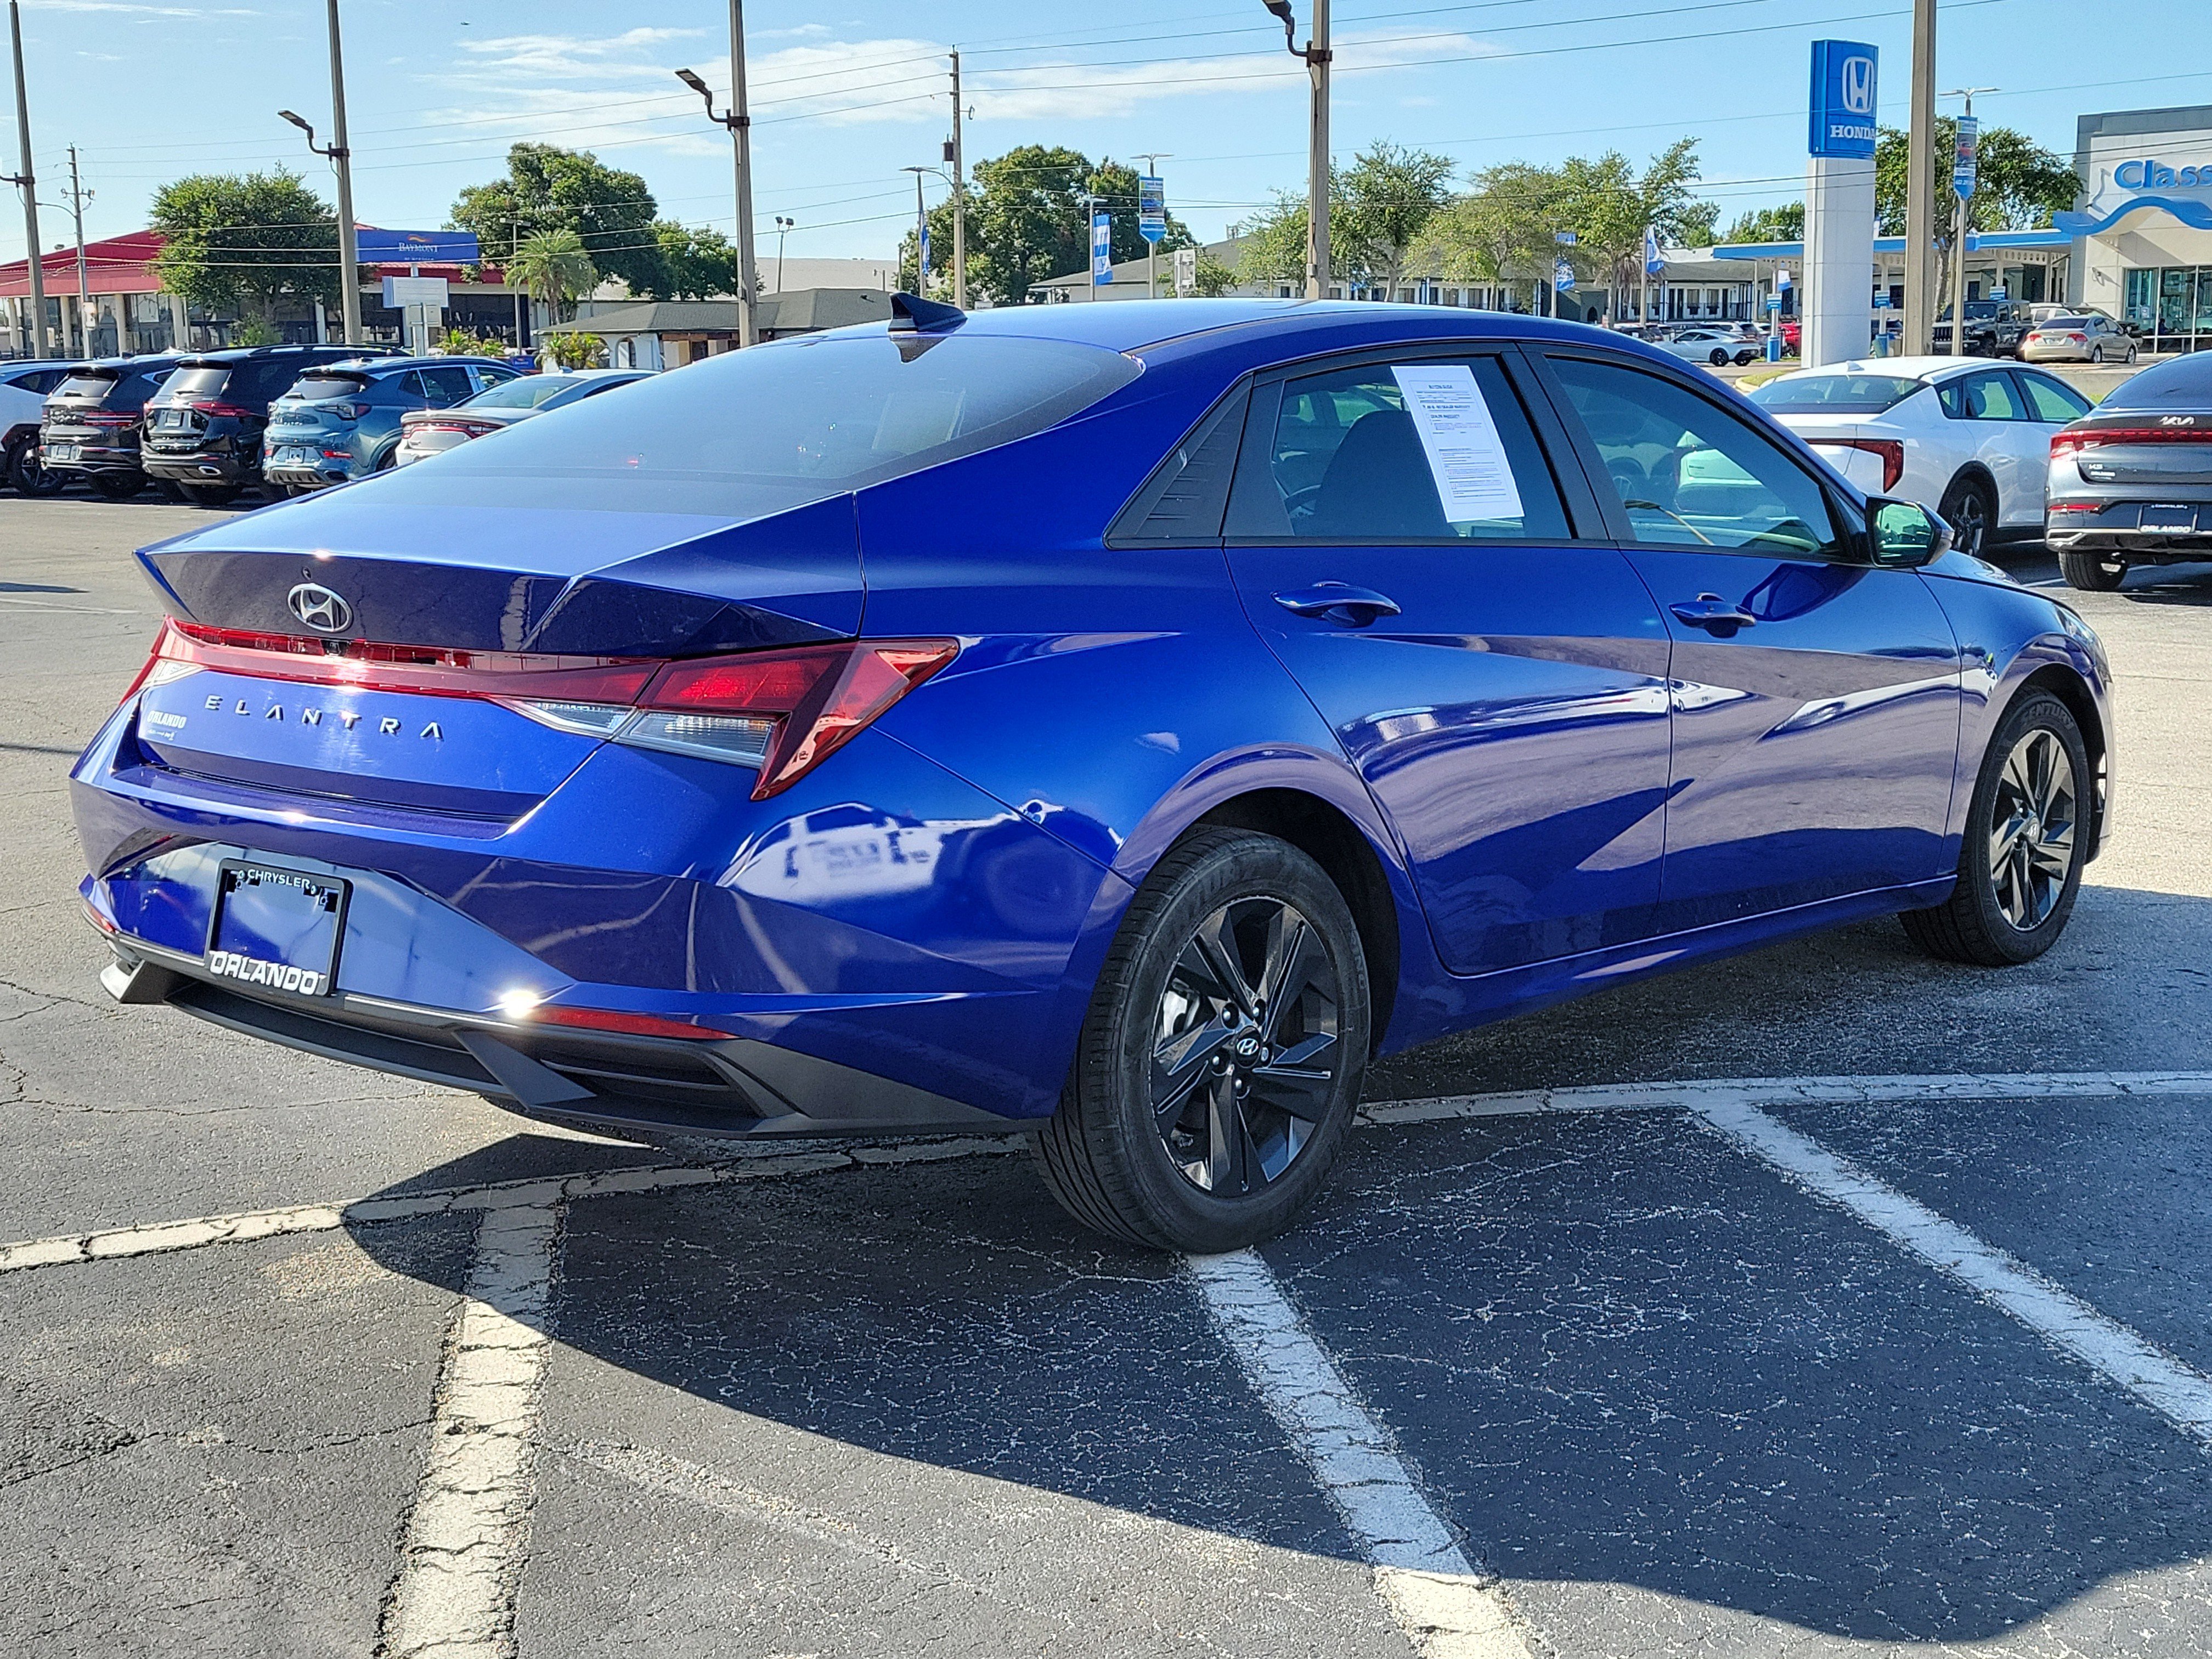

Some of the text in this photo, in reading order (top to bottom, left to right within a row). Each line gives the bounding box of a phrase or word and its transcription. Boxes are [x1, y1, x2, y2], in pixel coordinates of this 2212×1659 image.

[1830, 125, 1876, 140] HONDA
[2114, 160, 2212, 188] Class
[398, 242, 438, 253] BAYMONT
[2140, 525, 2191, 533] ORLANDO
[146, 710, 187, 729] ORLANDO
[205, 695, 443, 740] ELANTRA
[247, 869, 311, 889] CHRYSLER
[209, 950, 327, 996] ORLANDO
